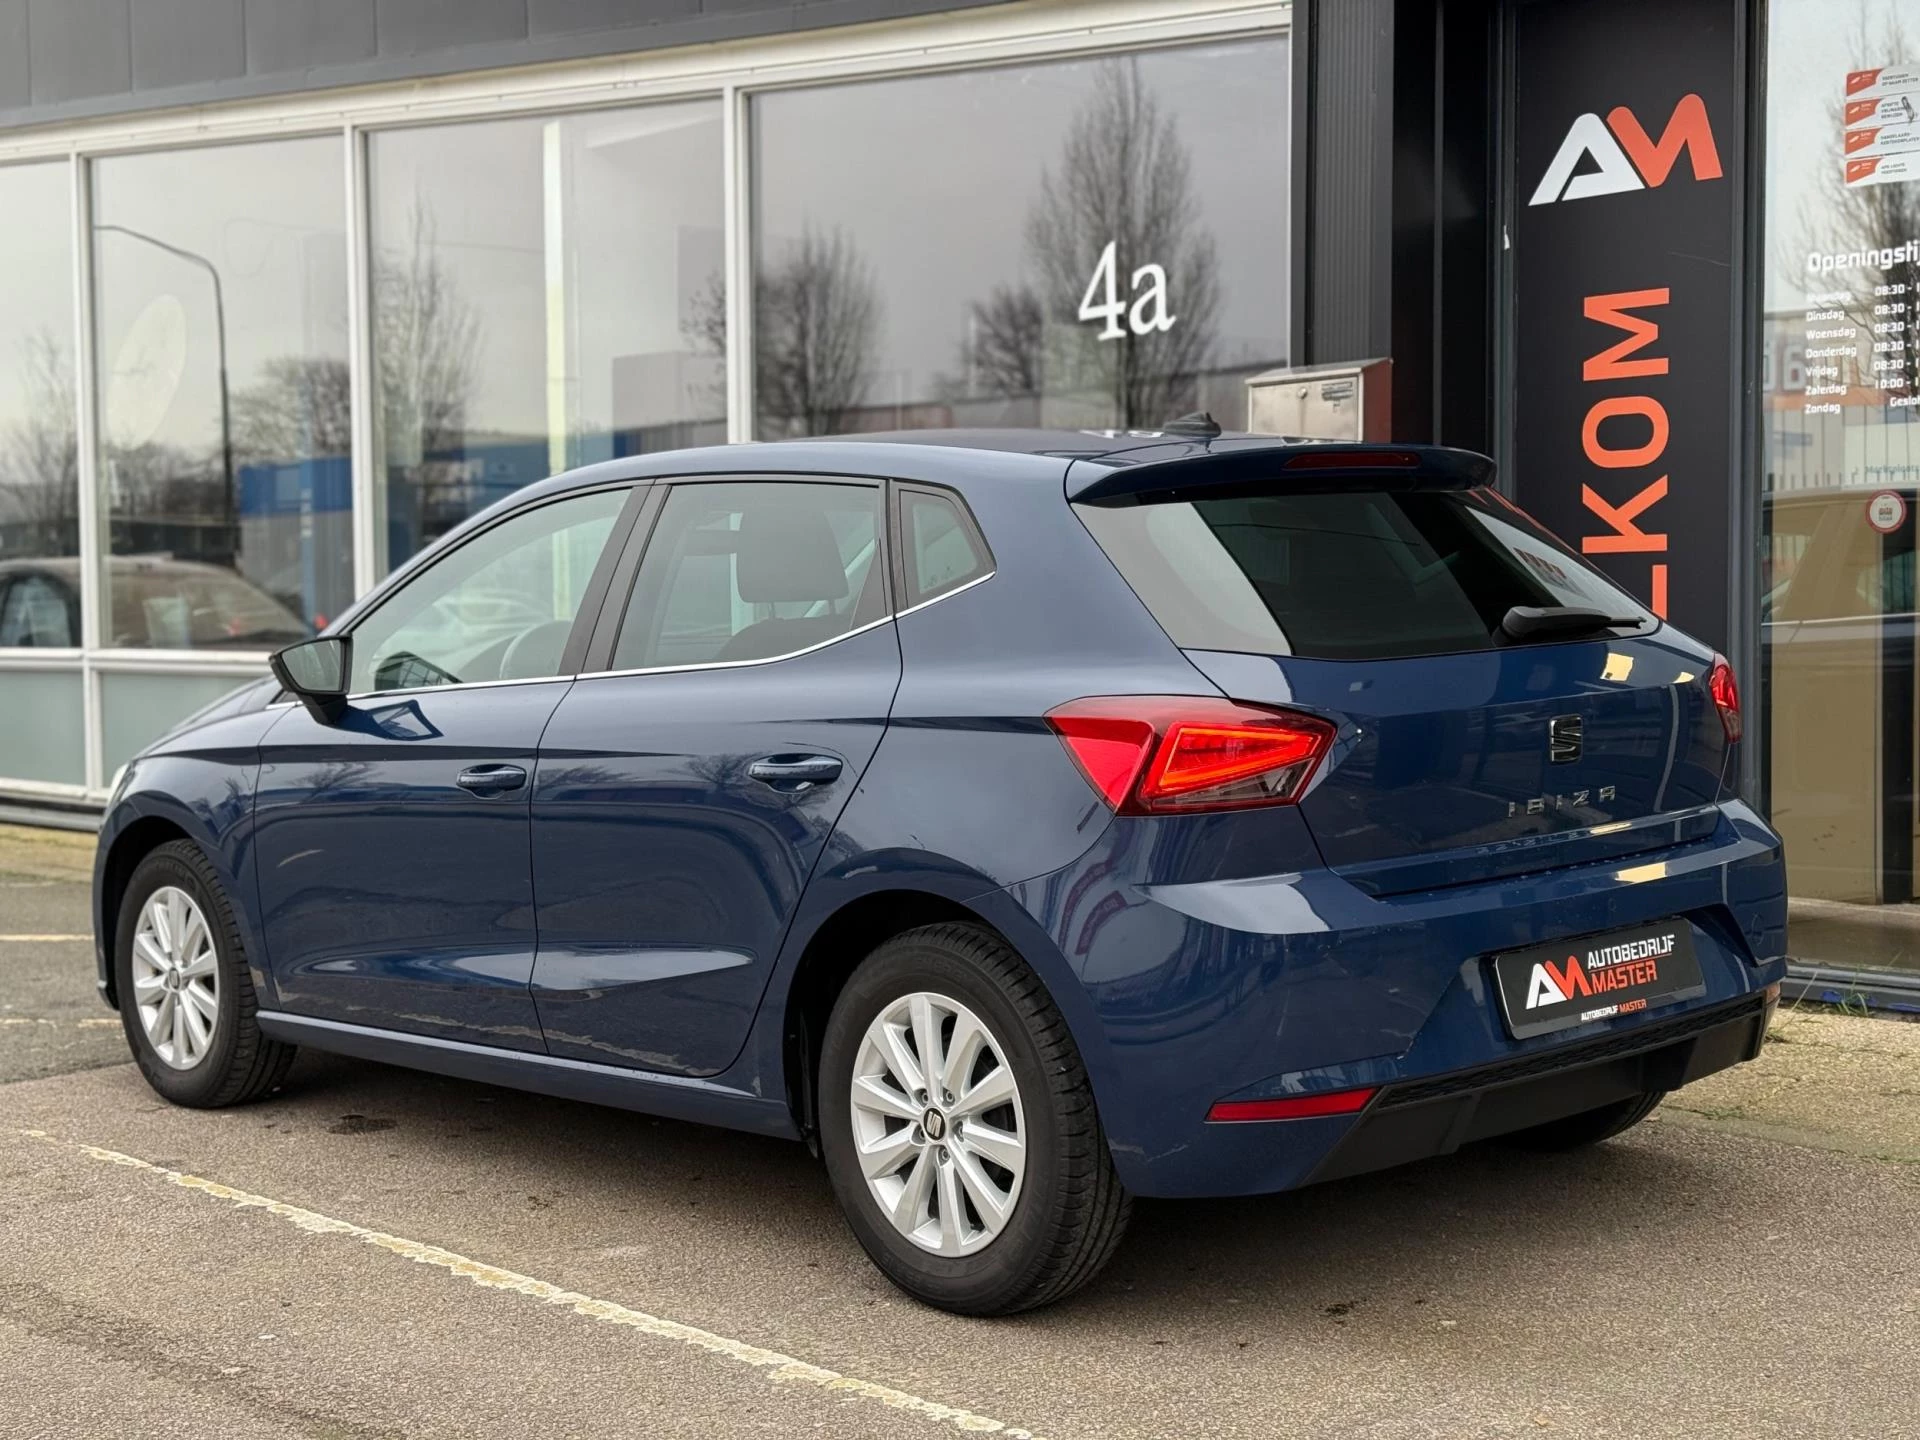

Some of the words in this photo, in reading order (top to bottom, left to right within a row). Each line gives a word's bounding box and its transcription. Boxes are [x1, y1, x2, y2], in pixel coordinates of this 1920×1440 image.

[1078, 240, 1177, 341] 4a
[1874, 284, 1904, 297] 08:30
[1806, 310, 1845, 322] Dinsdag
[1874, 303, 1904, 315] 08:30
[1805, 327, 1856, 340] Woensdag
[1874, 321, 1904, 334] 08:30
[1805, 346, 1857, 359] Donderdag
[1874, 341, 1904, 353] 08:30
[1805, 365, 1839, 379] Vrijdag
[1874, 359, 1904, 371] 08:30
[1805, 384, 1847, 396] Zaterdag
[1874, 378, 1904, 390] 10:00
[1805, 403, 1841, 415] Zondag
[1507, 785, 1616, 819] IBIZA
[1587, 934, 1676, 970] AUTOBEDRIJF
[1590, 959, 1658, 995] MASTER
[1581, 1004, 1619, 1022] AUTOBEDRIJF
[1619, 998, 1648, 1014] MASTER
